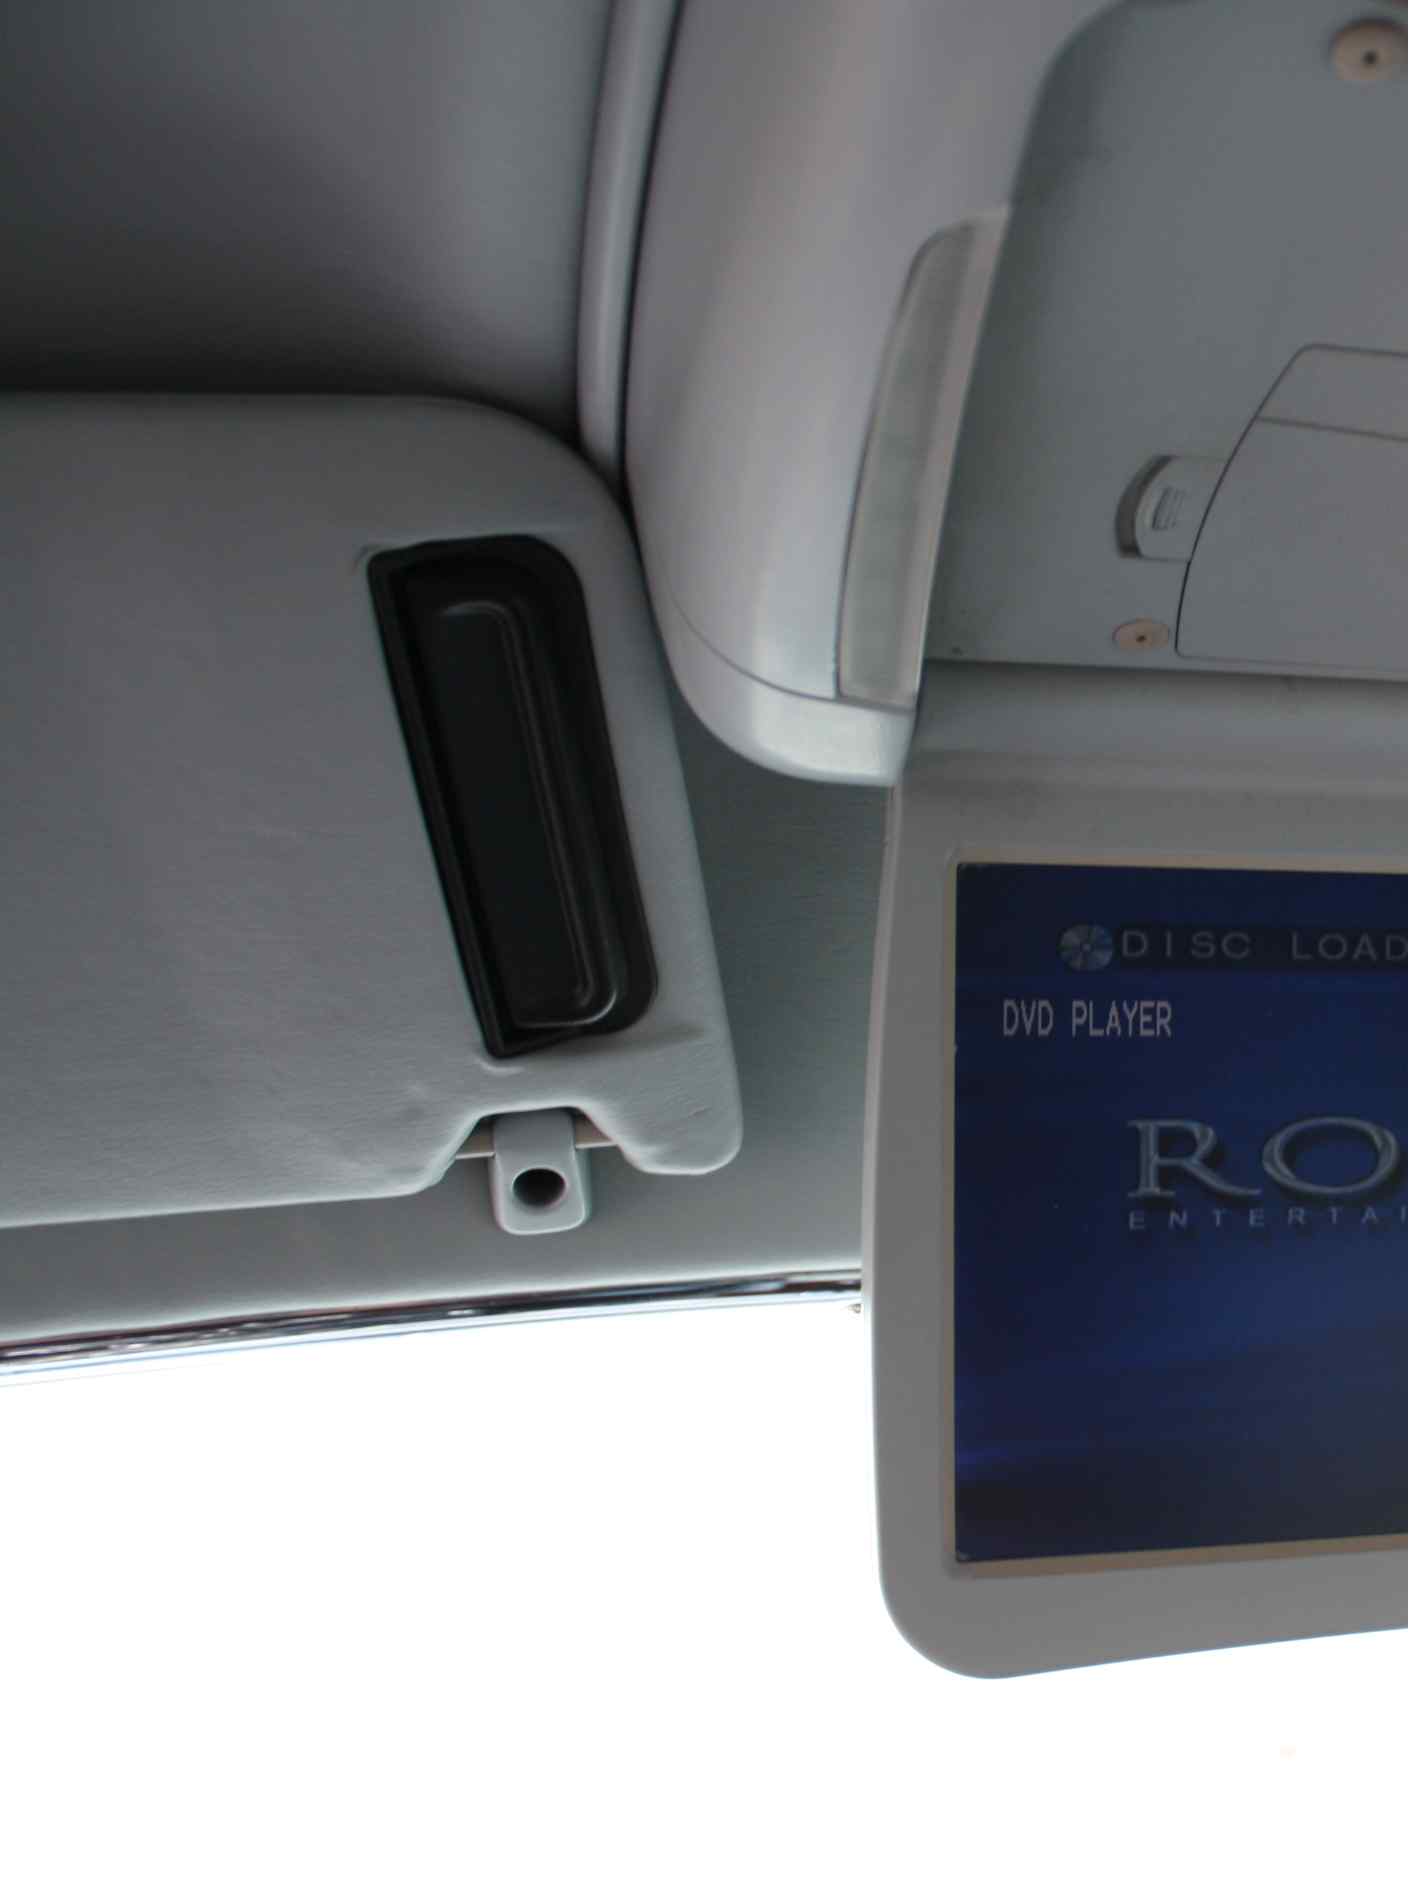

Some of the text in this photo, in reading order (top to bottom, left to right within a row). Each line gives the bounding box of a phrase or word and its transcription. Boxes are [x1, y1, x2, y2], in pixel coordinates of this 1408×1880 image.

[1120, 930, 1252, 960] DISC
[1001, 999, 1172, 1038] DVD PLAYER
